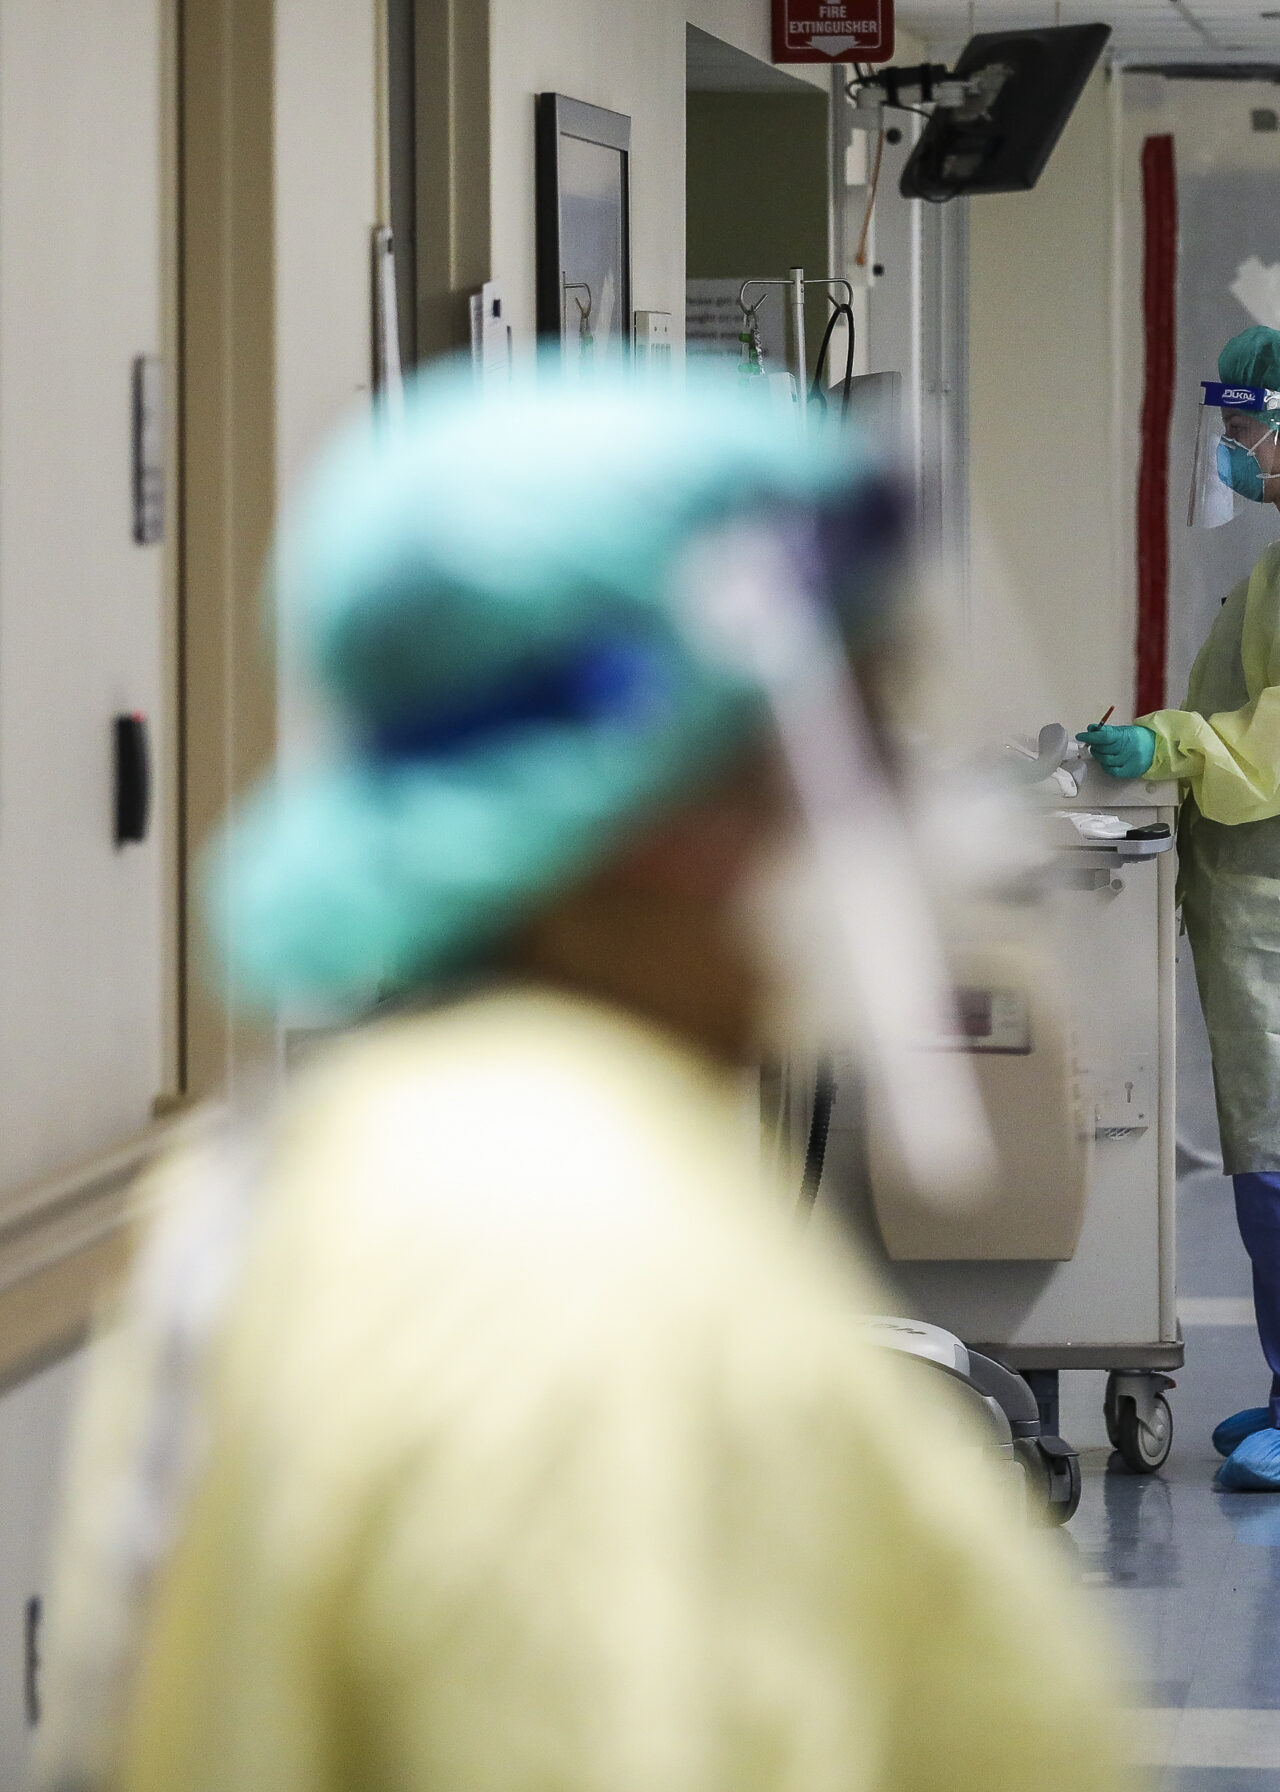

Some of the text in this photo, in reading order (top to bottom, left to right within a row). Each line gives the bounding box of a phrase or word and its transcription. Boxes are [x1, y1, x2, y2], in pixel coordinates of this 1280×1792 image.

[819, 6, 847, 18] FIRE
[789, 20, 878, 34] EXTINGUISHER
[1221, 389, 1256, 401] DUKAL
